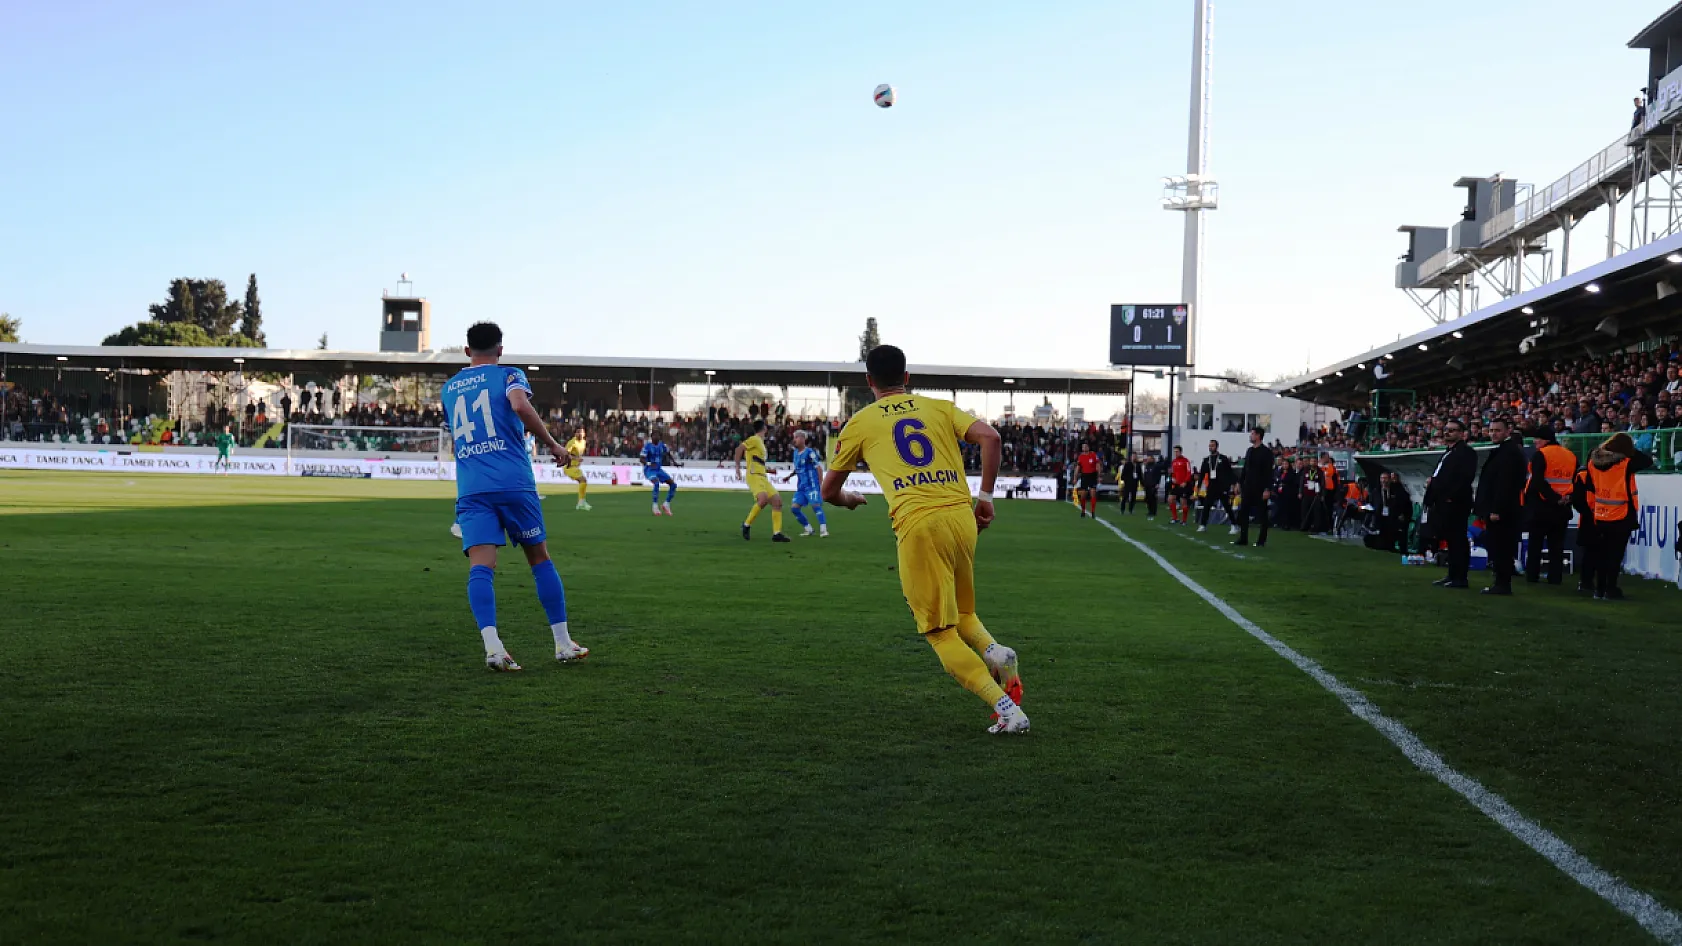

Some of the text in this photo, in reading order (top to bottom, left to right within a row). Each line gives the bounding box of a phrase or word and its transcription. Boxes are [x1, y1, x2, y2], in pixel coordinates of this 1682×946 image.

[1143, 308, 1165, 320] 61:21
[1134, 325, 1173, 343] 0 1
[878, 399, 915, 413] YKT
[453, 389, 497, 443] 41
[892, 418, 934, 467] 6
[36, 455, 104, 466] TAMER TANCA
[122, 458, 190, 469] TAMER TANCA
[243, 462, 276, 471] TANCA
[894, 470, 958, 491] R.YALÇIN
